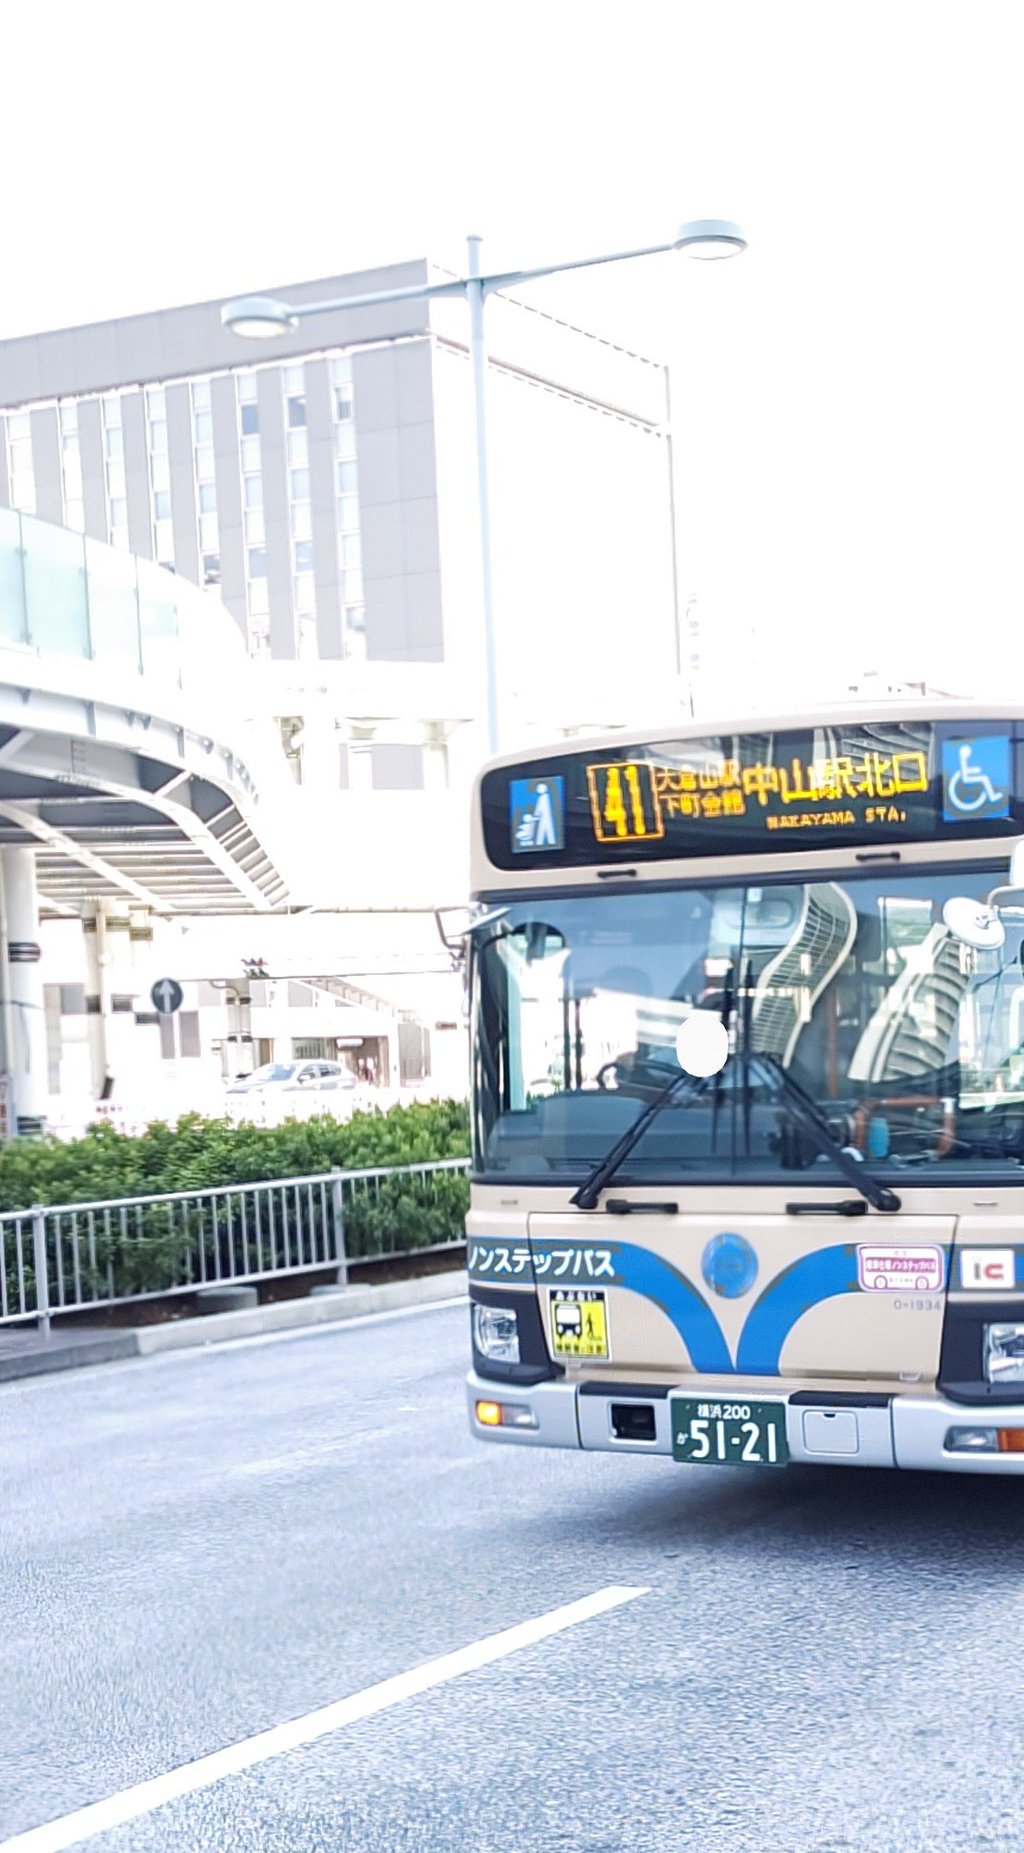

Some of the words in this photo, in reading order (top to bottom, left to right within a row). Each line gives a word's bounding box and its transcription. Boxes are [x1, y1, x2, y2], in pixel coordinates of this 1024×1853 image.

[603, 764, 647, 837] 41
[742, 752, 928, 807] 中山駅北口
[767, 810, 856, 830] NAKAYAMA
[468, 1245, 616, 1278] ノンステップバス
[690, 1419, 777, 1463] 51-21
